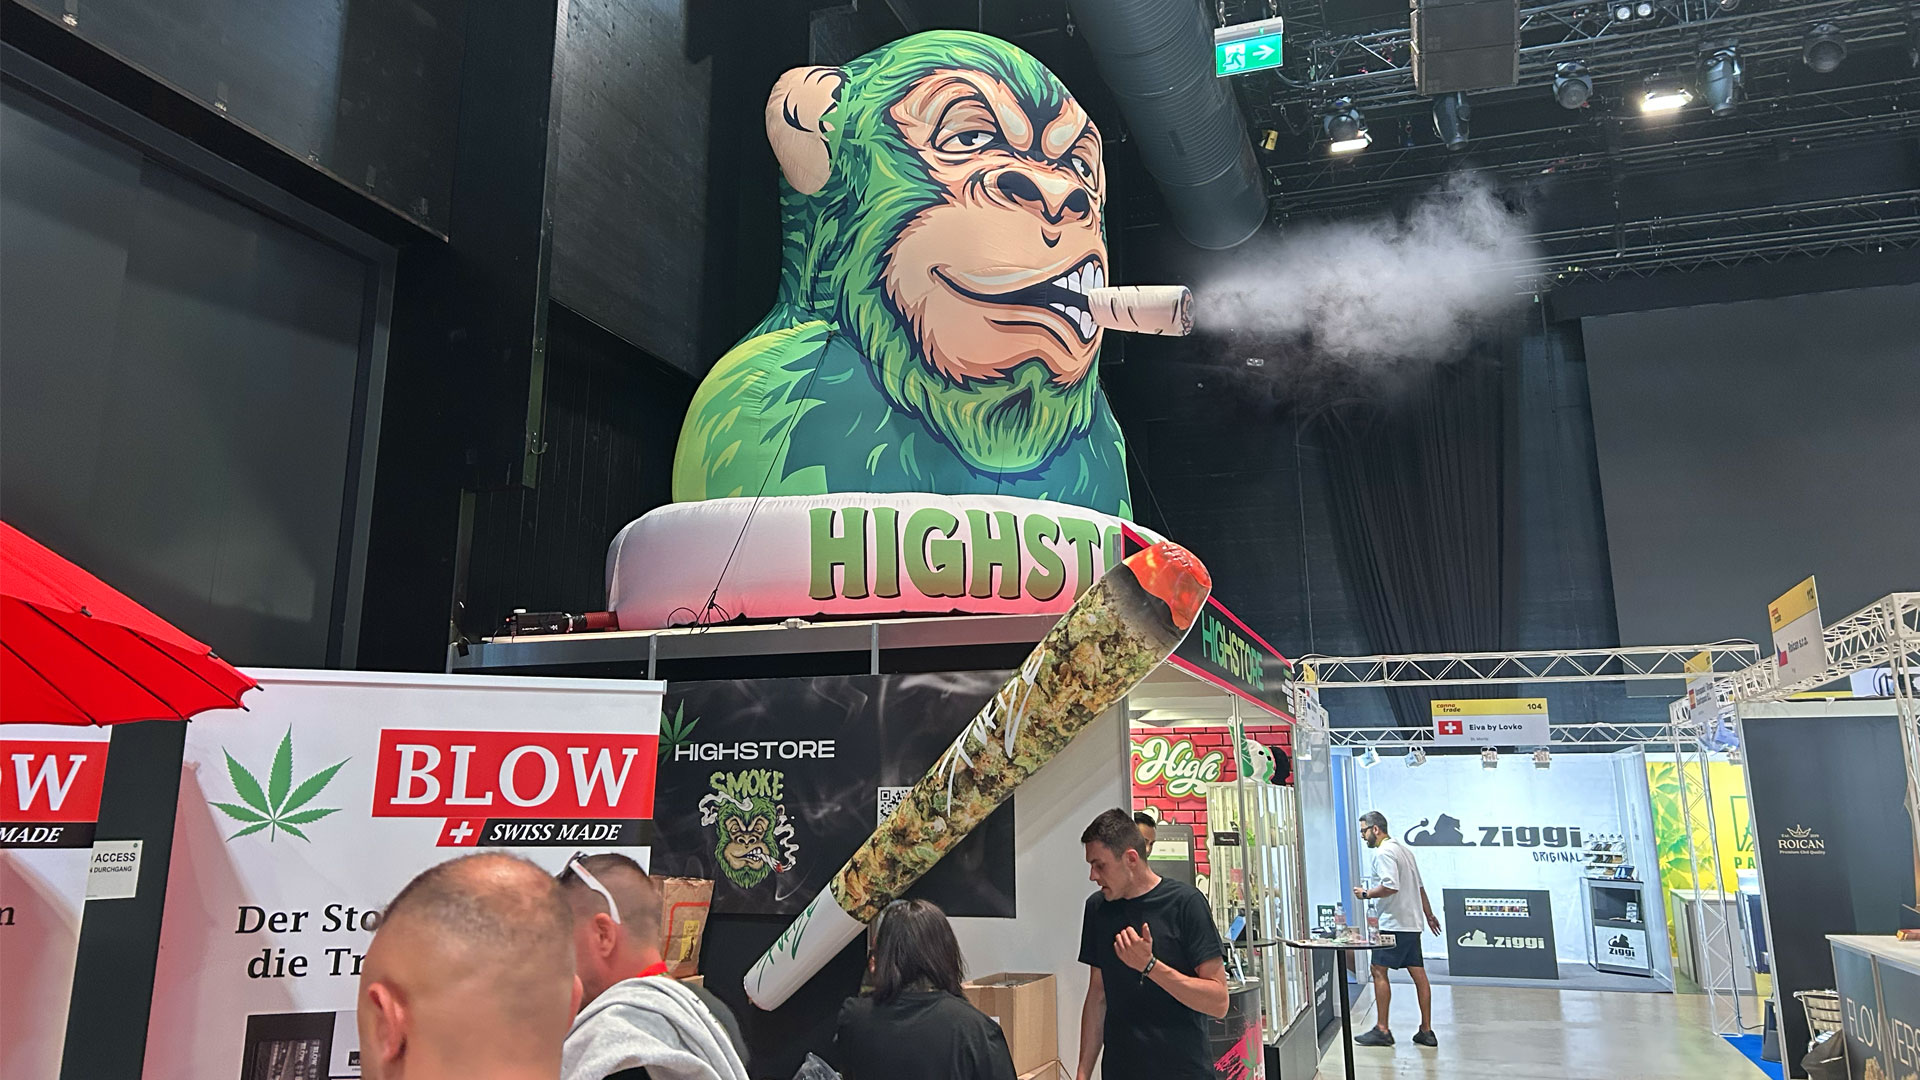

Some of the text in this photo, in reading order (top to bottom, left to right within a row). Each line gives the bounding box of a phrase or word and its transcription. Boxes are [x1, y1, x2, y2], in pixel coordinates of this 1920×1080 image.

[1201, 610, 1264, 692] HIGHSTORE
[1487, 723, 1497, 732] by
[1498, 723, 1523, 731] Lovko
[674, 740, 836, 762] HIGHSTORE
[1133, 737, 1224, 795] High
[390, 744, 639, 808] BLOW
[709, 769, 785, 801] SMOKE
[0, 827, 64, 843] MADE
[490, 824, 622, 841] SWISS MADE
[1778, 839, 1825, 849] ROICAN
[94, 852, 136, 863] ACCESS
[1532, 851, 1583, 863] ORIGINAL
[1734, 857, 1756, 869] PA
[93, 865, 132, 874] DURCHGANG
[235, 904, 382, 934] Der Sto
[247, 948, 367, 979] die Tr
